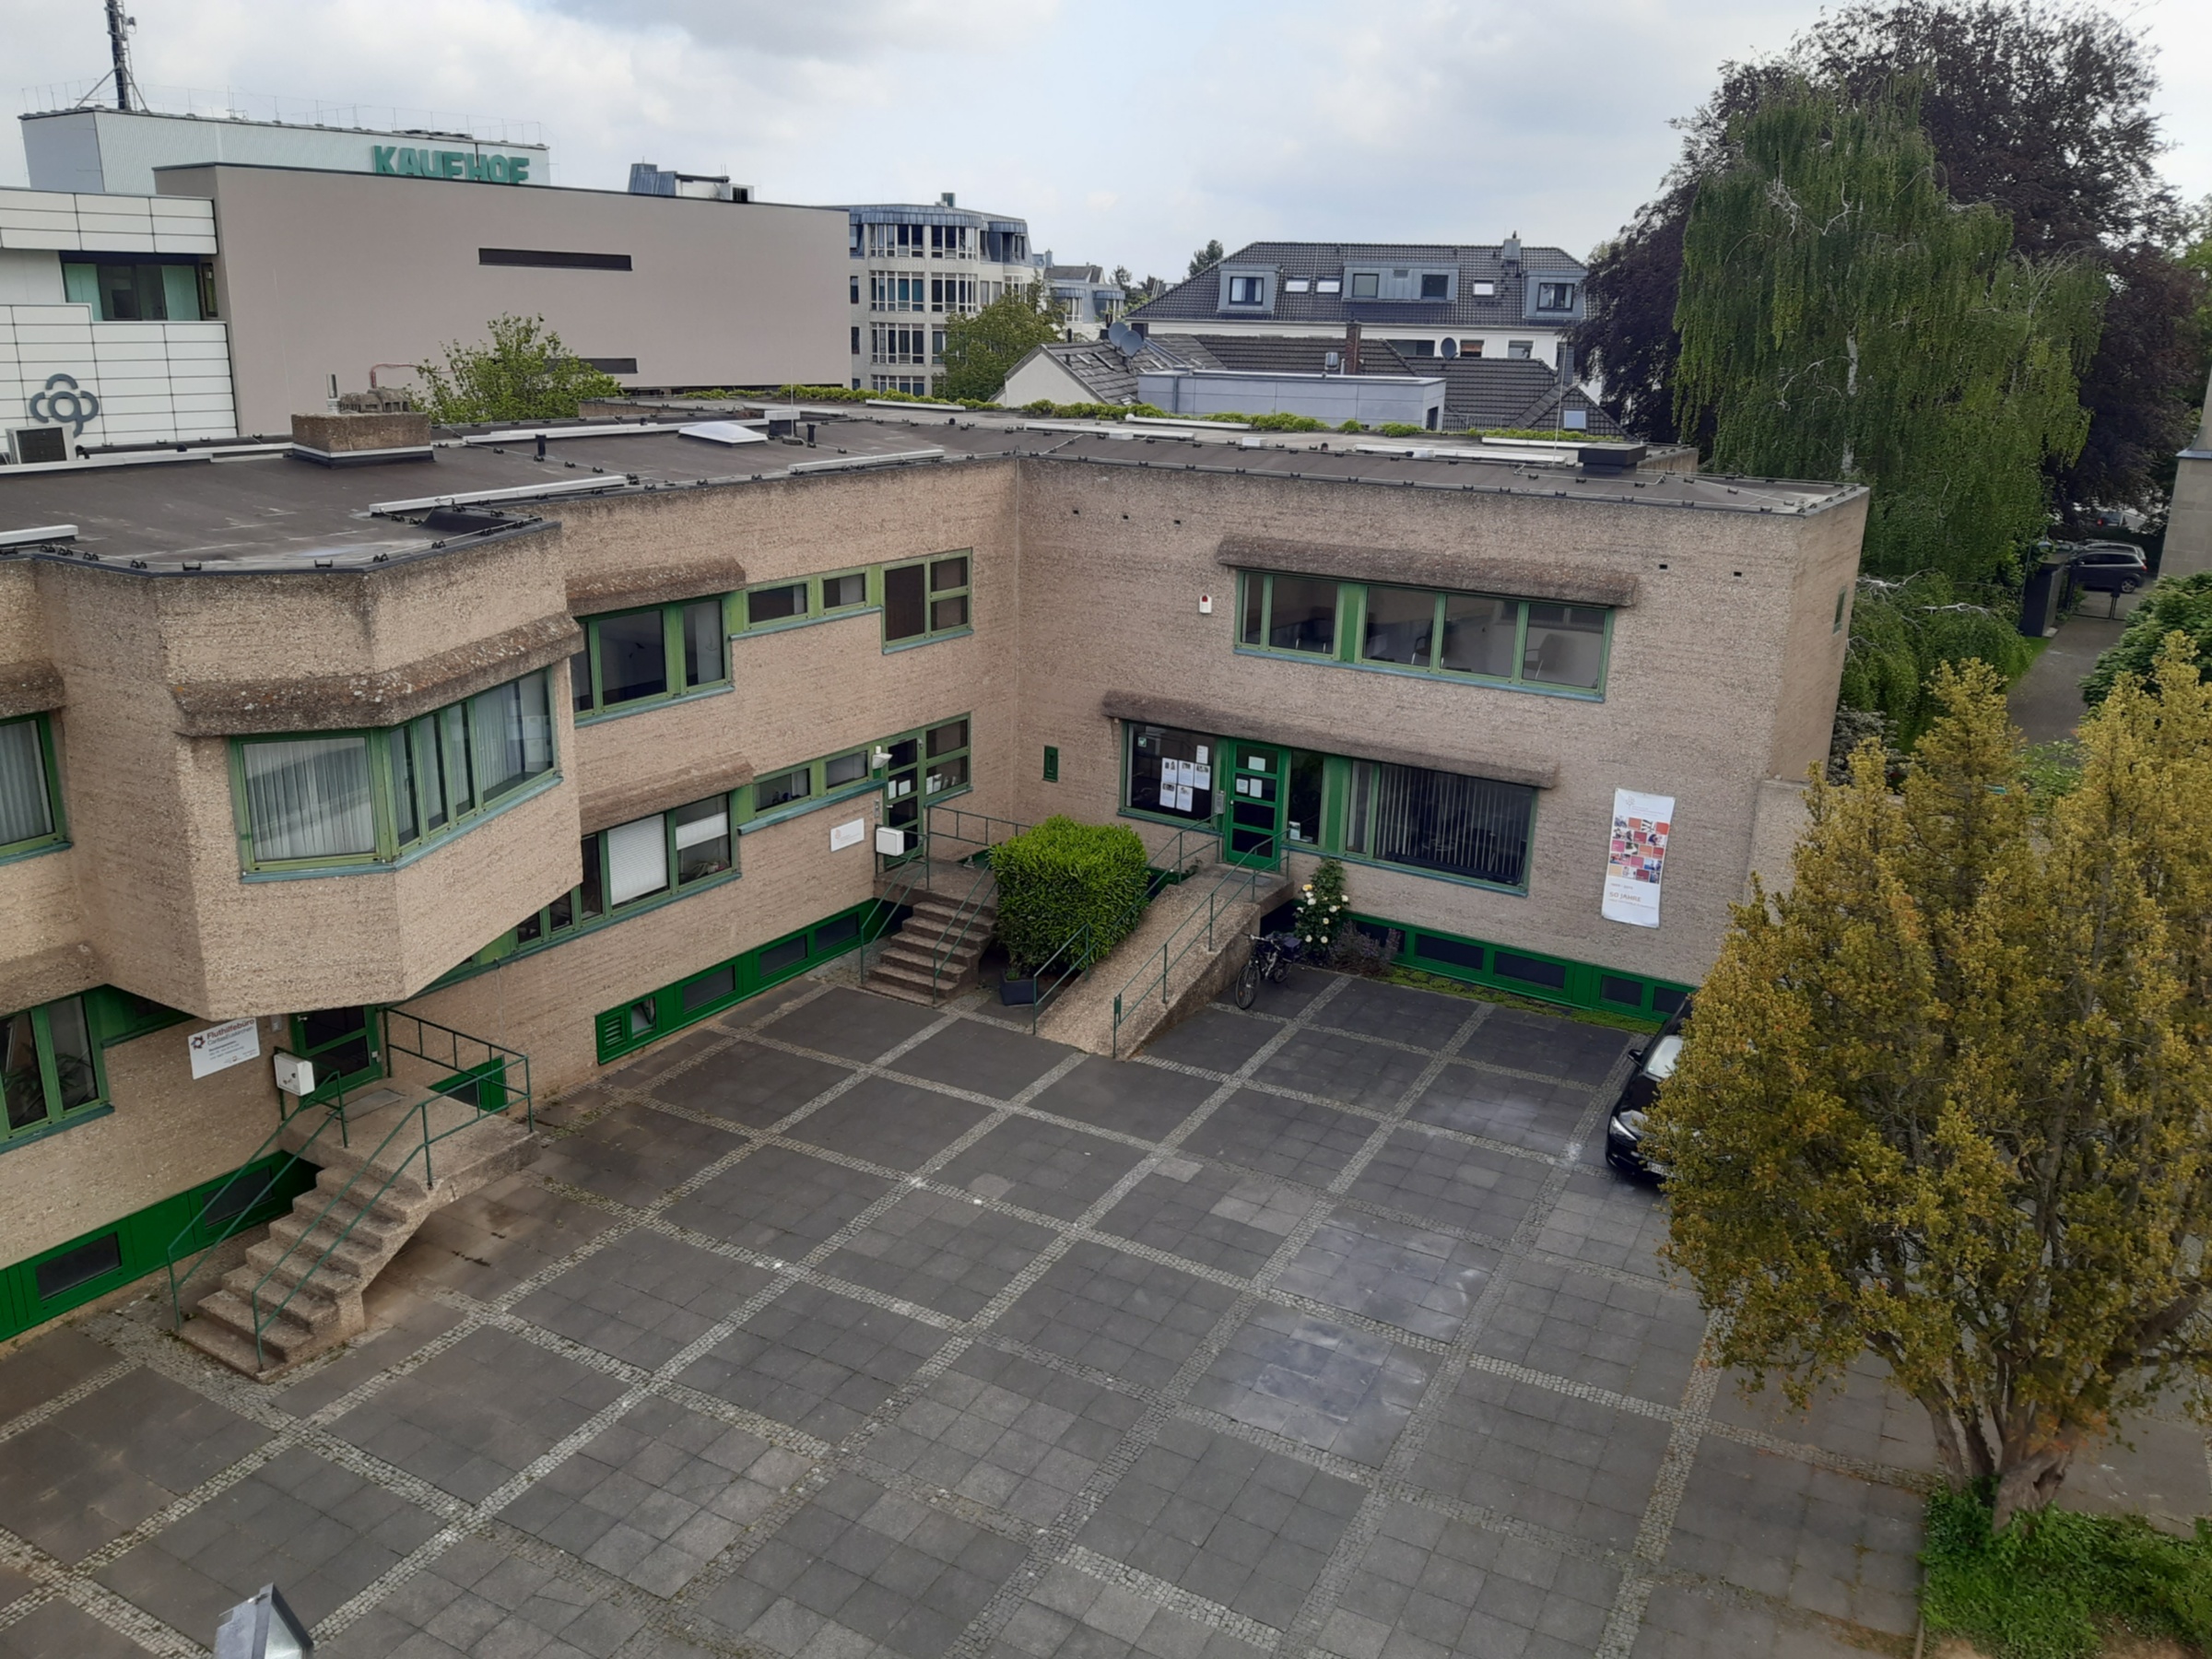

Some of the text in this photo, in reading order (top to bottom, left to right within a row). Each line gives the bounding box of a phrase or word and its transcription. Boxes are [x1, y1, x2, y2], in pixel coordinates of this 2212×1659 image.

[373, 145, 530, 184] KAUFHOF
[1619, 893, 1641, 902] JAHRE
[206, 1018, 255, 1040] Fluthilfebüro
